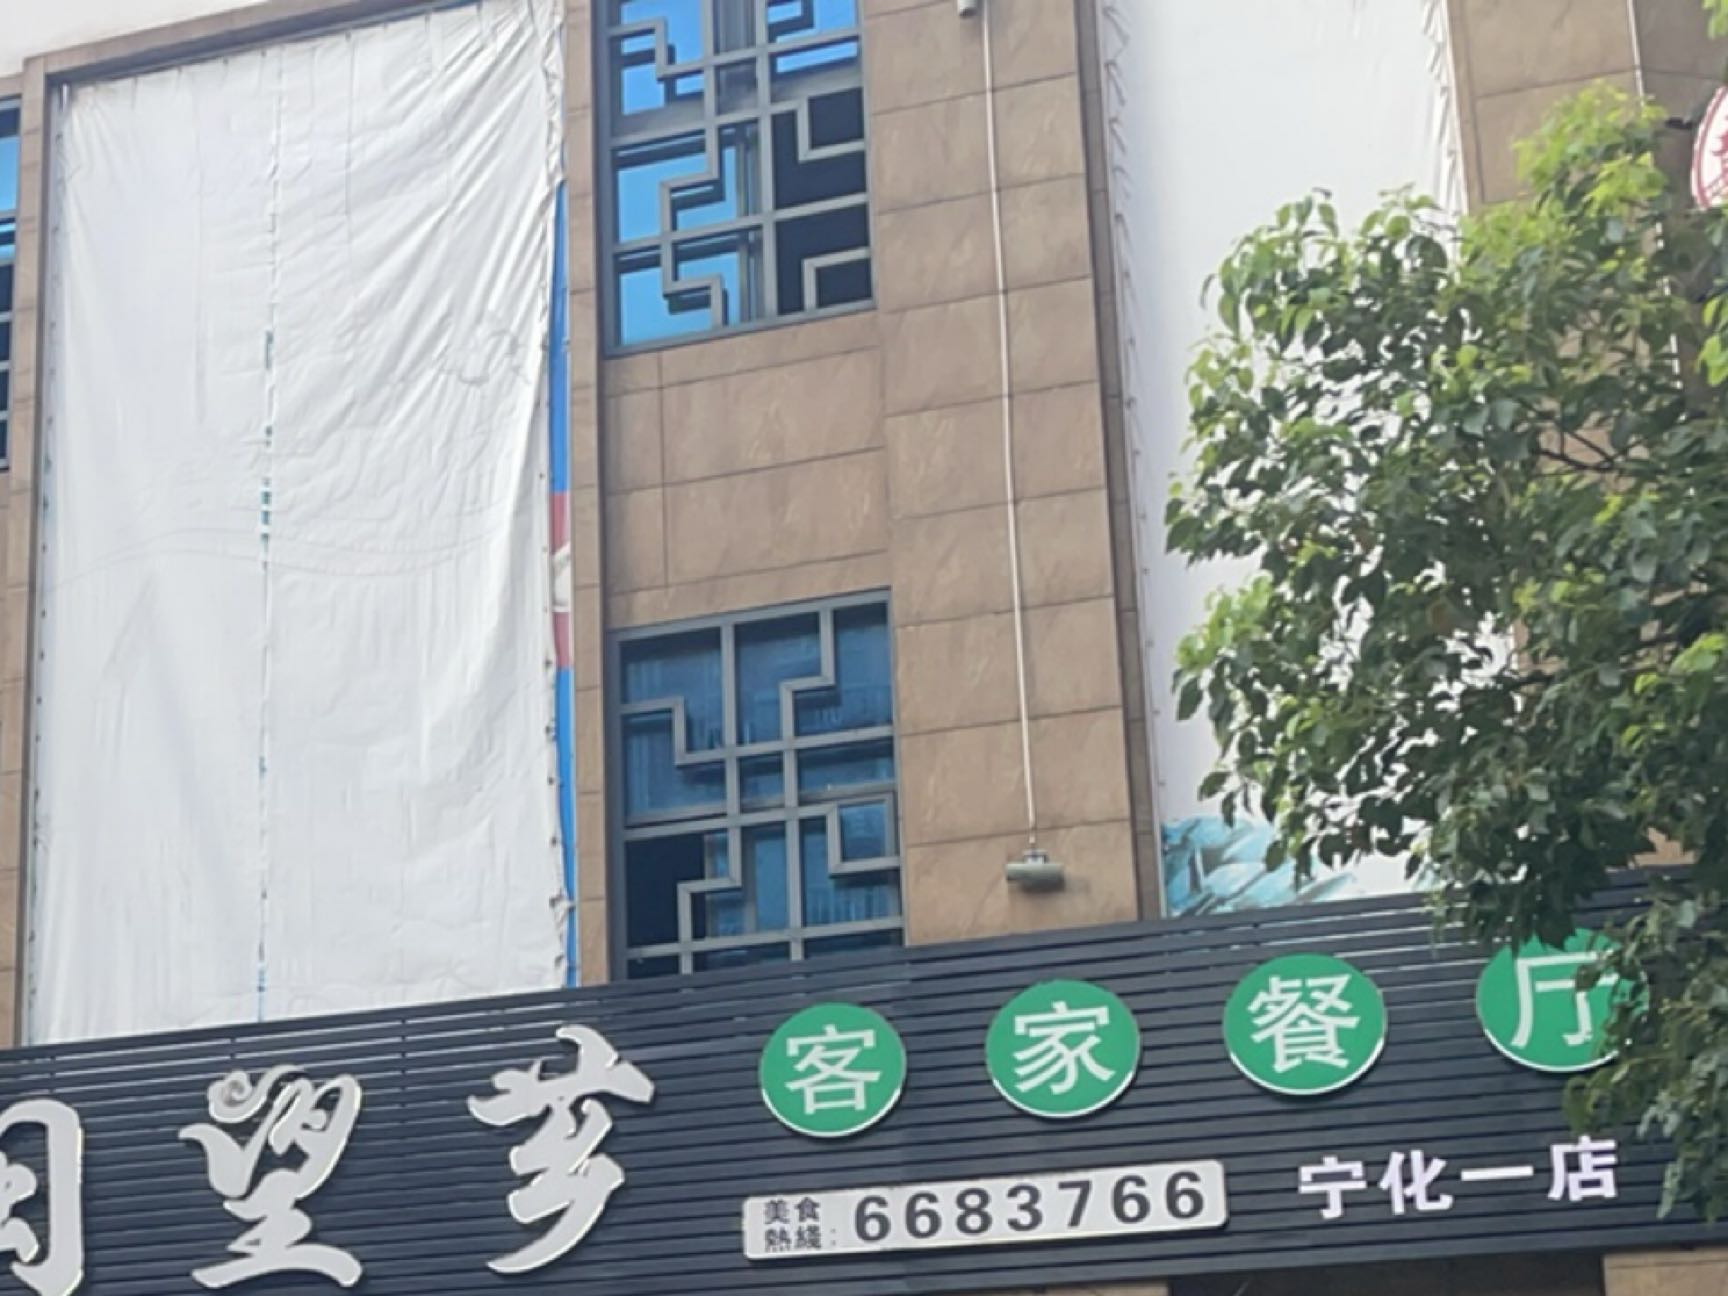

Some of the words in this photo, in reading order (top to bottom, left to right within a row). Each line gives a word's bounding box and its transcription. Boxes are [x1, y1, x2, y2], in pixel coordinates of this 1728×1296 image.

[785, 948, 1620, 1116] 客家餐厅
[763, 1196, 821, 1224] 美食
[854, 1170, 1204, 1242] 6683766
[1298, 1136, 1619, 1220] 宁化一店
